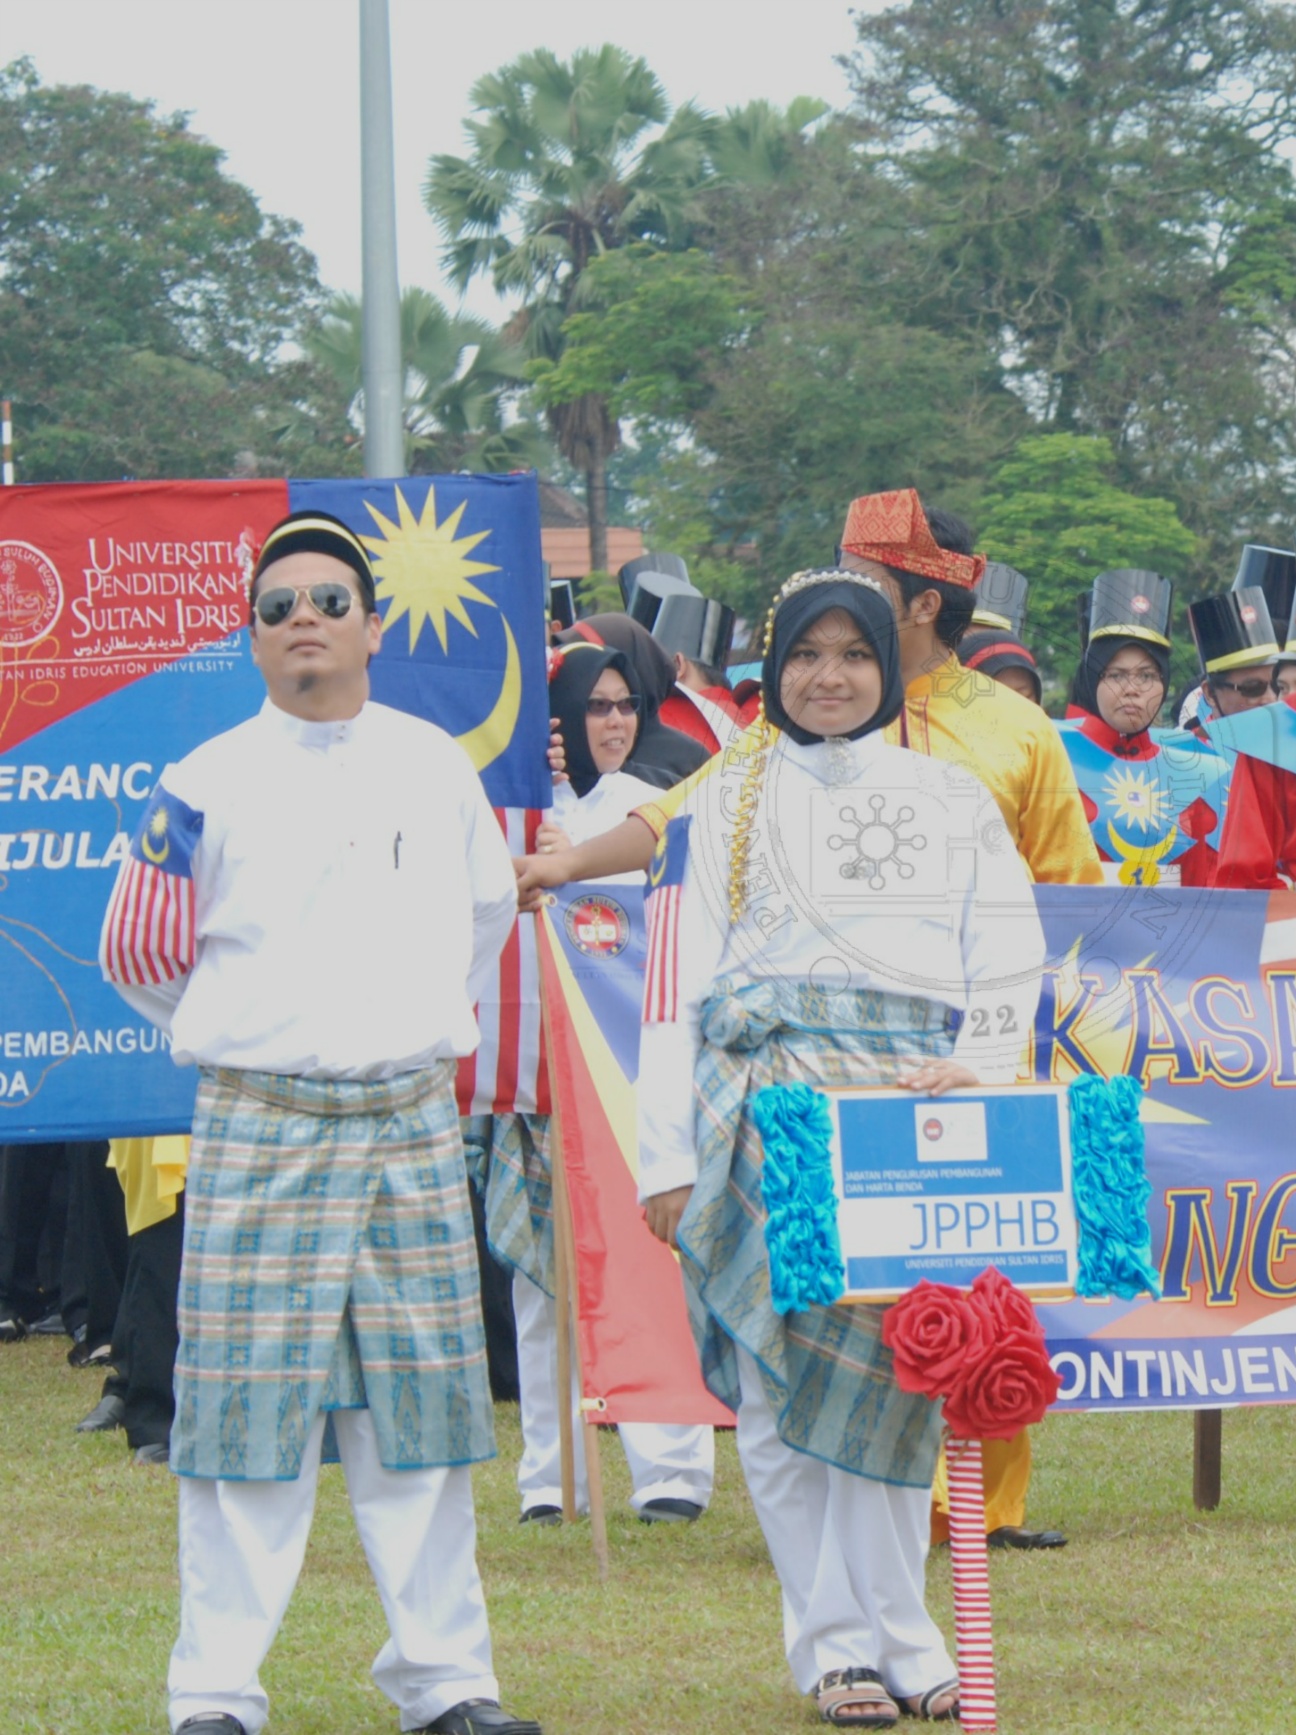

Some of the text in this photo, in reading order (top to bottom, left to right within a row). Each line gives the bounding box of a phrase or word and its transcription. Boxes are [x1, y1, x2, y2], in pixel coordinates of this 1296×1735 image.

[89, 537, 234, 573] UNIVERSITI
[83, 568, 238, 607] PENDIDIKAN
[71, 597, 242, 638] SULTAN IDRIS
[30, 666, 67, 680] IDRIS
[73, 661, 147, 678] EDUCATION
[153, 659, 234, 675] UNIVERSITY
[846, 1167, 1002, 1182] JABATAN PENGURUSAN PEMBANGUNAN
[846, 1181, 923, 1195] DAN HARTA BENDA
[909, 1199, 1060, 1251] JPPHB
[905, 1252, 1065, 1270] UNIVERSITI PENDIDIKAN SULTAN IDRIS
